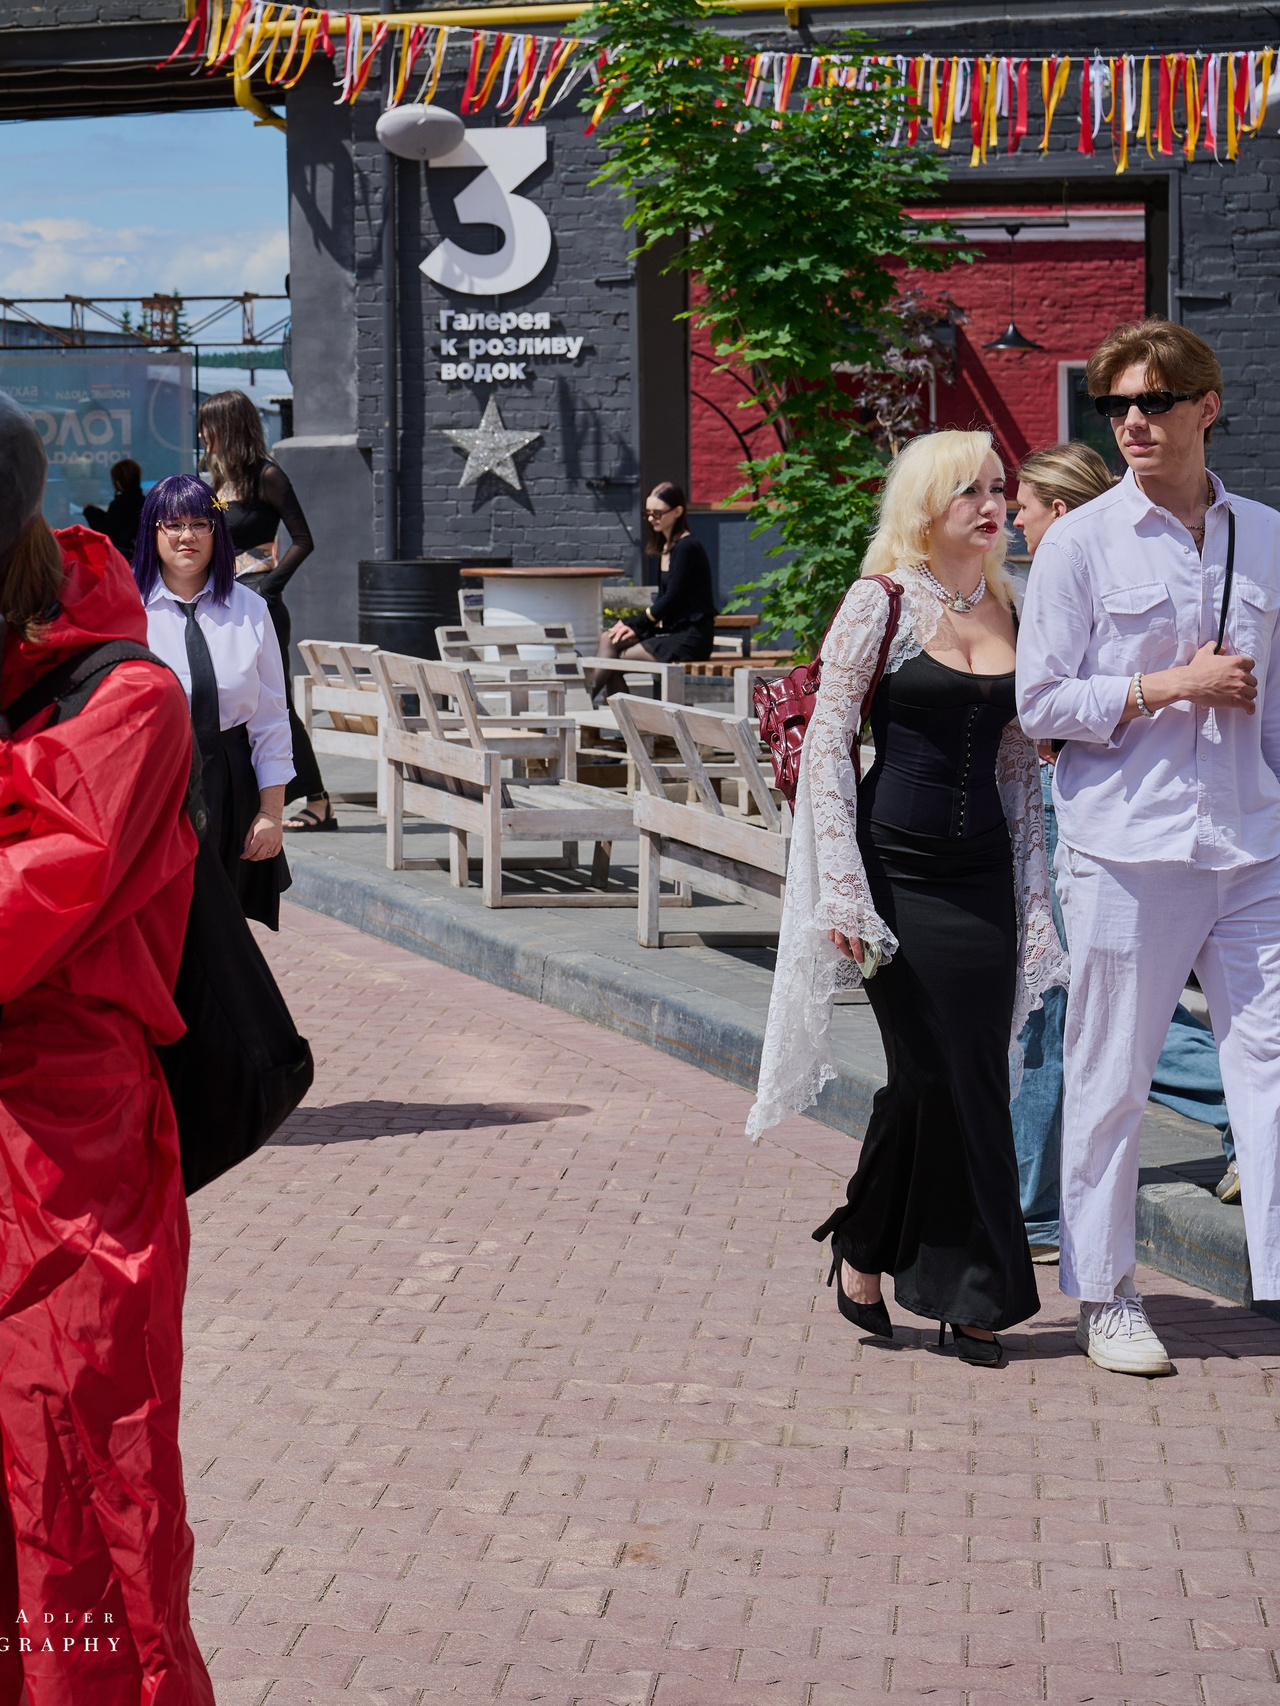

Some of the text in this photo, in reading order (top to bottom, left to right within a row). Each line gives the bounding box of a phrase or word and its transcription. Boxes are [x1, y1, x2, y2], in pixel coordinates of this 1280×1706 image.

[418, 126, 552, 296] 3
[439, 310, 551, 334] Галерея
[440, 336, 584, 359] к розливу
[440, 362, 527, 383] водок
